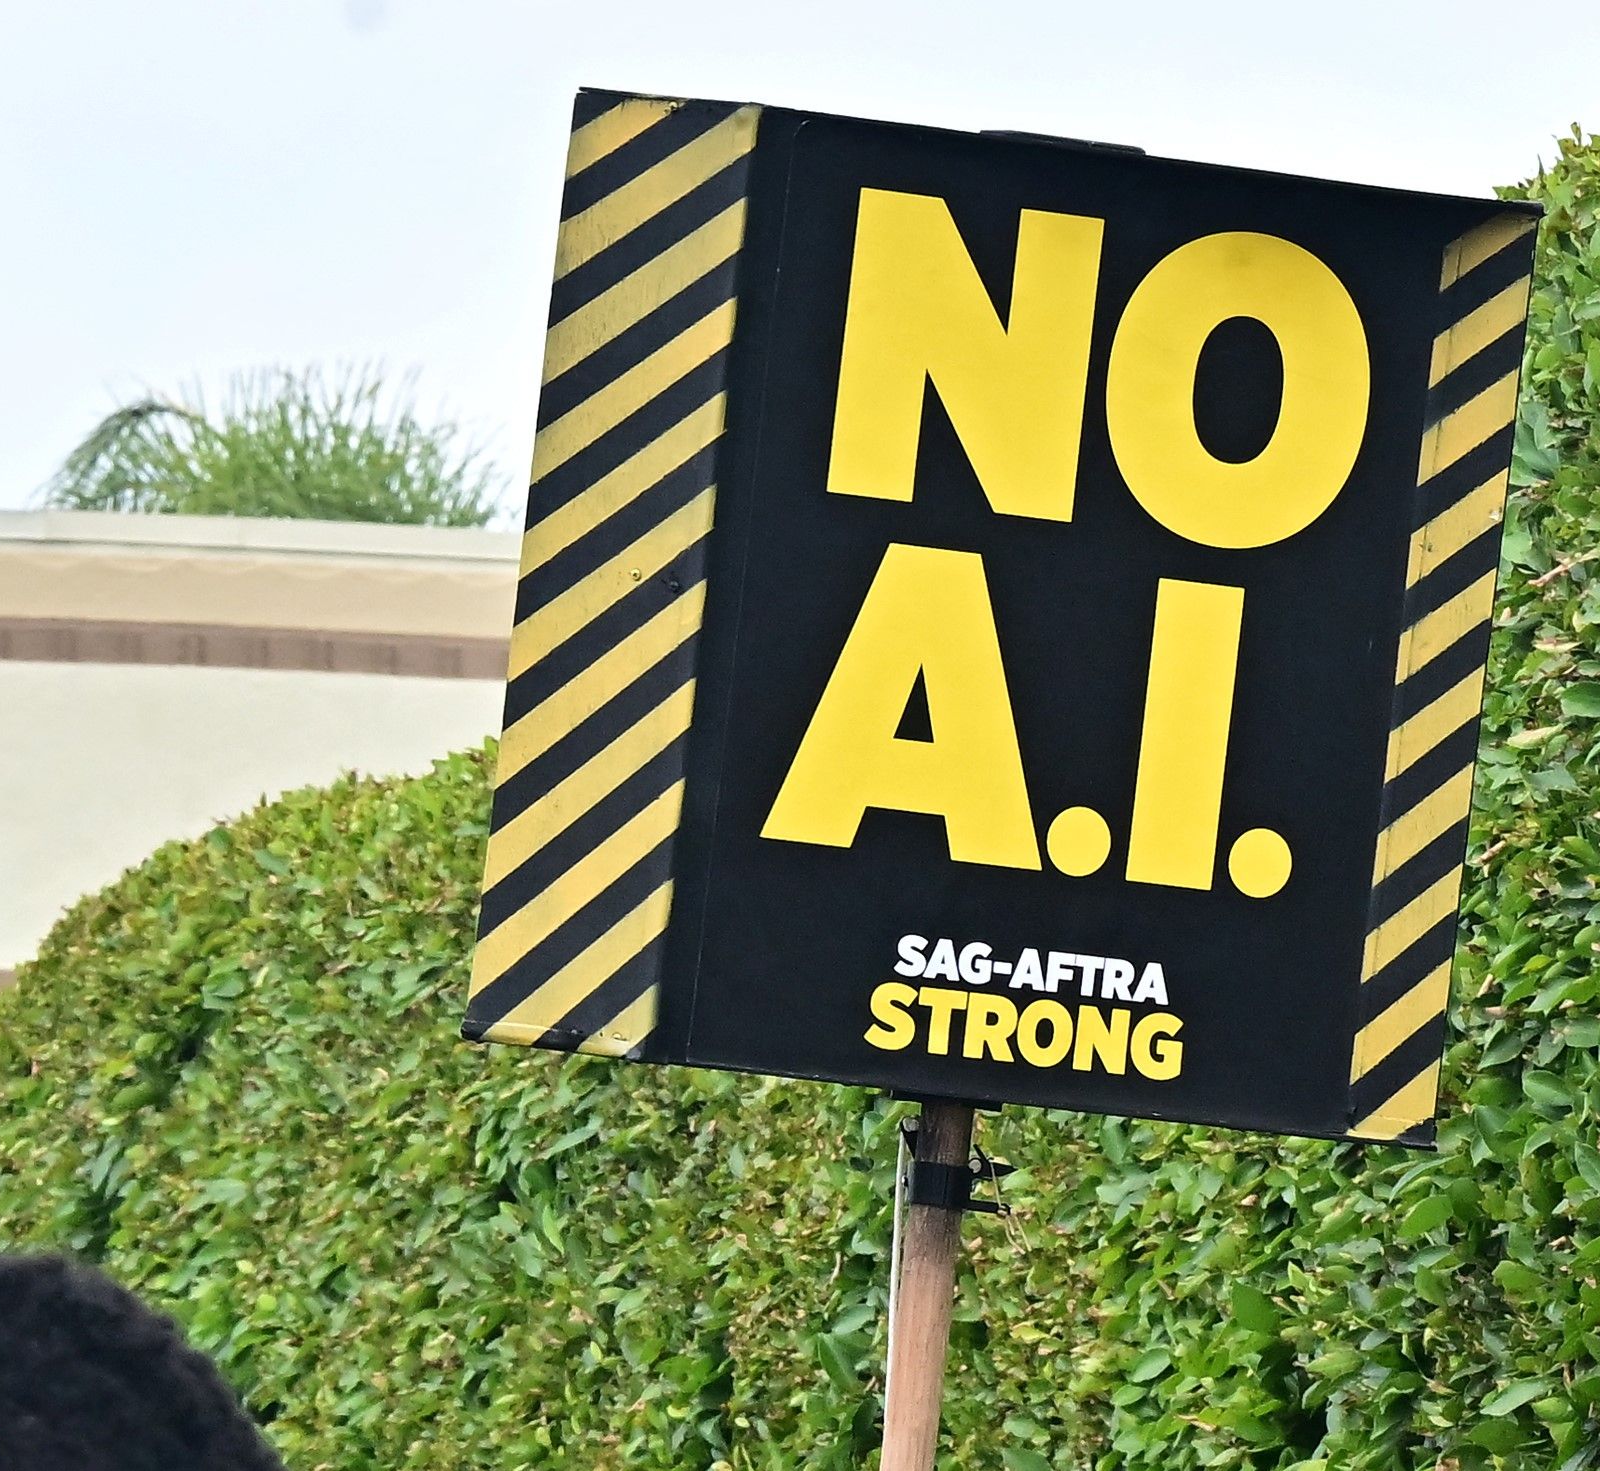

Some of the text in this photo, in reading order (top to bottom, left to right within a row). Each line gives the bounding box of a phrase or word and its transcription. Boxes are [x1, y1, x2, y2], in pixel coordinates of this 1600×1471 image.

[826, 187, 1371, 550] NO
[759, 543, 1293, 900] A.I.
[863, 982, 1184, 1081] STRONG
[893, 933, 1169, 1006] SAG-AFTRA
